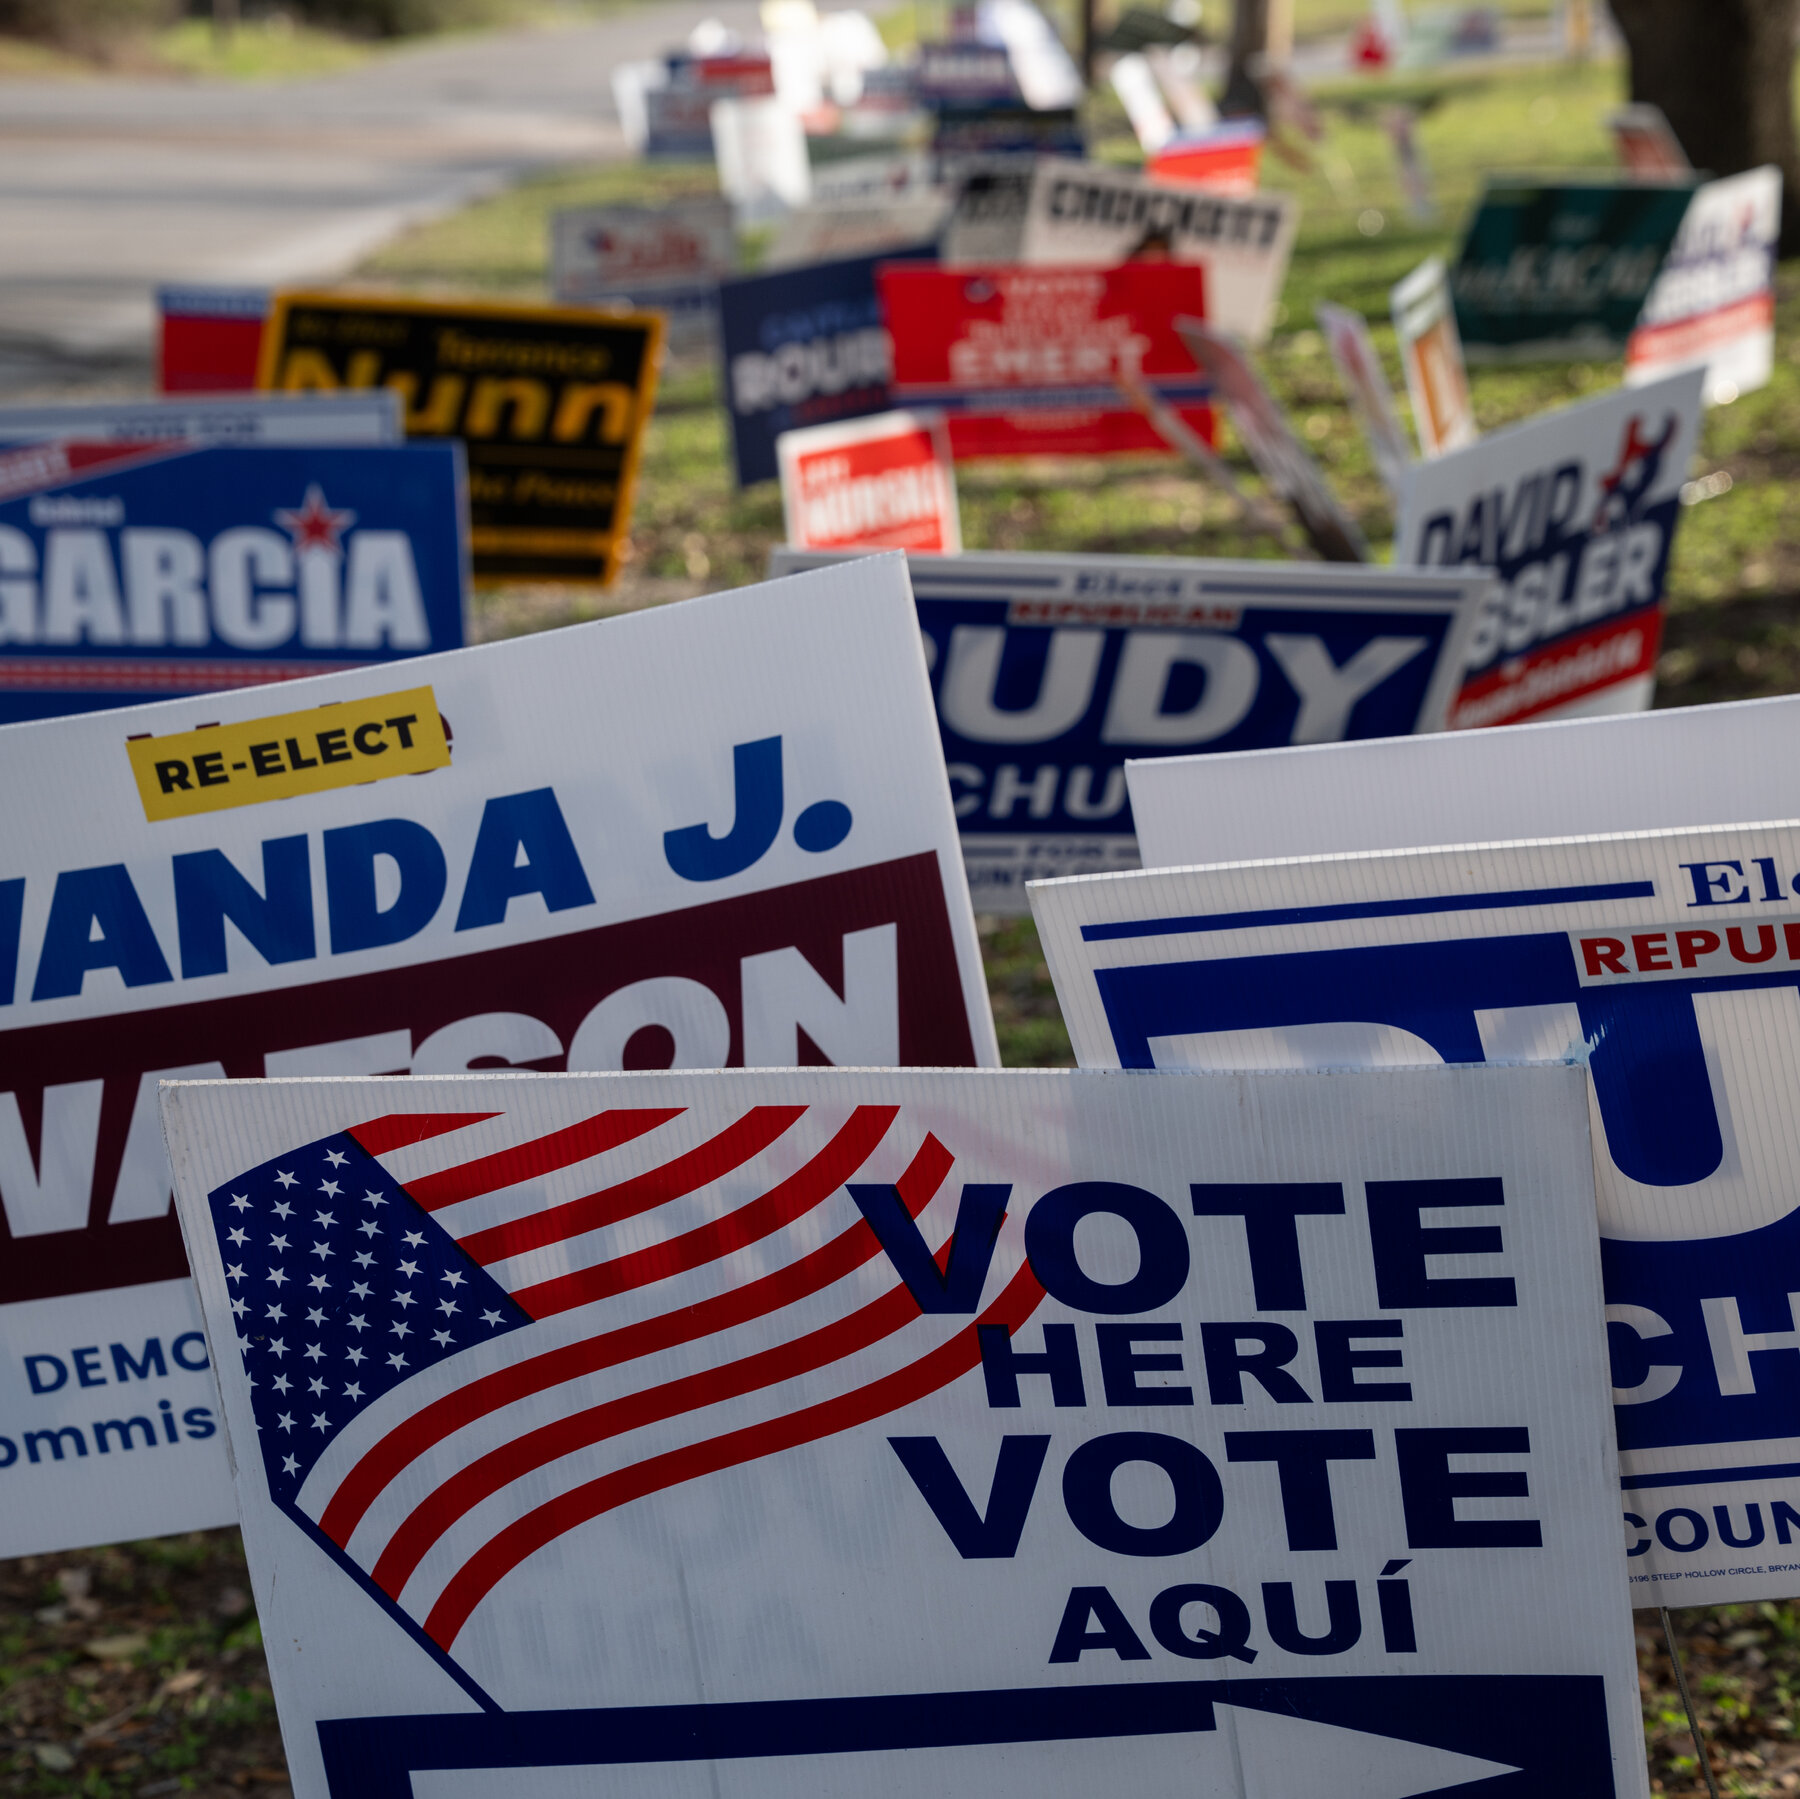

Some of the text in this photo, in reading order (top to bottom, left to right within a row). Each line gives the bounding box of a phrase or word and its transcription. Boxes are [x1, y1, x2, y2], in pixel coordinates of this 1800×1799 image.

[1010, 603, 1243, 629] REPUBLICAN
[1073, 573, 1184, 596] Elect
[922, 624, 1429, 746] UDY
[154, 714, 418, 794] RE-ELECT
[0, 734, 853, 1005] ANDA J.
[1679, 856, 1800, 907] El
[844, 1176, 1518, 1315] VOTE
[976, 1319, 1414, 1408] HERE
[886, 1426, 1543, 1560] VOTE
[1047, 1559, 1418, 1664] AQUÍ
[1651, 1572, 1682, 1582] STEEP
[1685, 1569, 1726, 1579] HOLLOW
[1728, 1566, 1766, 1576] CIRCLE,
